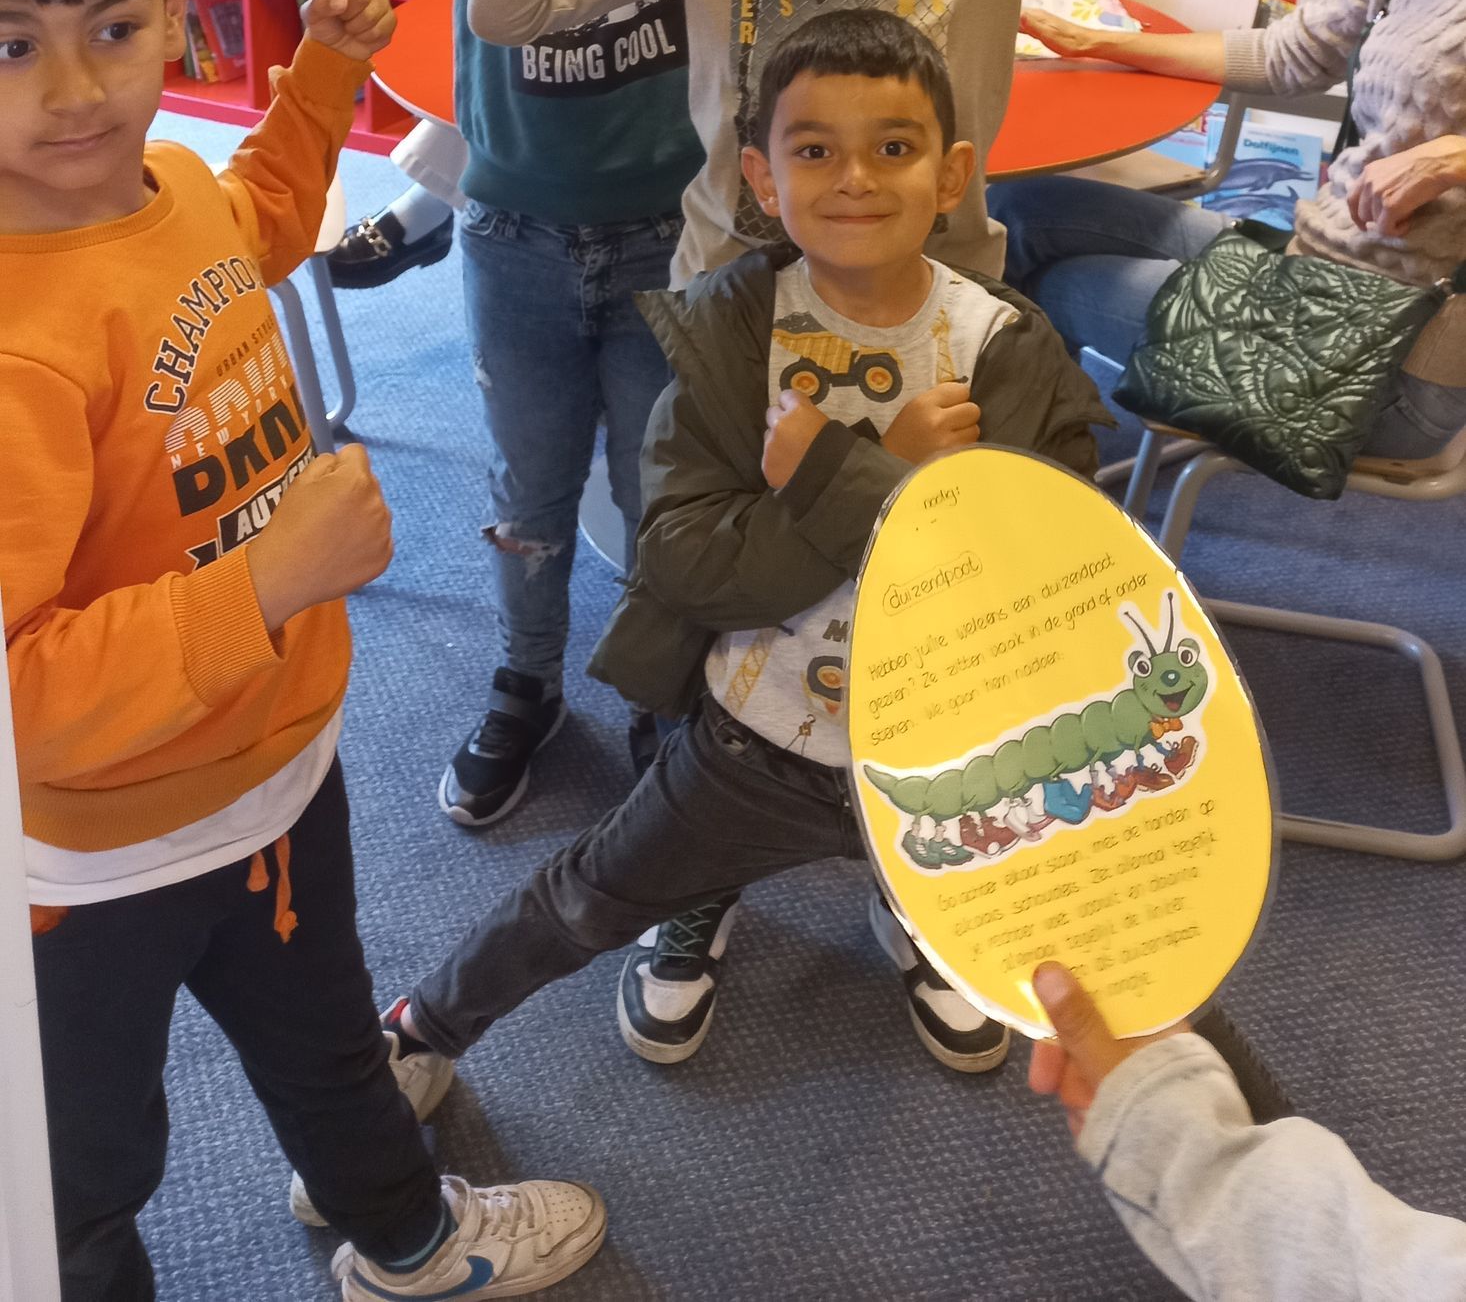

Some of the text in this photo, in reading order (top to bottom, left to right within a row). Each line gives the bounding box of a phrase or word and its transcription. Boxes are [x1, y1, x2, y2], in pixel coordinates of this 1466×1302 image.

[522, 18, 677, 83] BEING COOL
[216, 340, 250, 377] URBAN
[169, 426, 231, 470] NEW
[889, 556, 980, 609] duizendpoot
[868, 652, 912, 681] Hebben
[1013, 594, 1036, 613] een
[1041, 553, 1116, 599] duizendpoot
[922, 671, 939, 689] Ze
[1044, 615, 1062, 633] de
[1065, 595, 1097, 631] grond
[1099, 587, 1112, 606] of
[1115, 572, 1148, 598] onder
[949, 687, 980, 716] gaan
[1122, 825, 1141, 842] de
